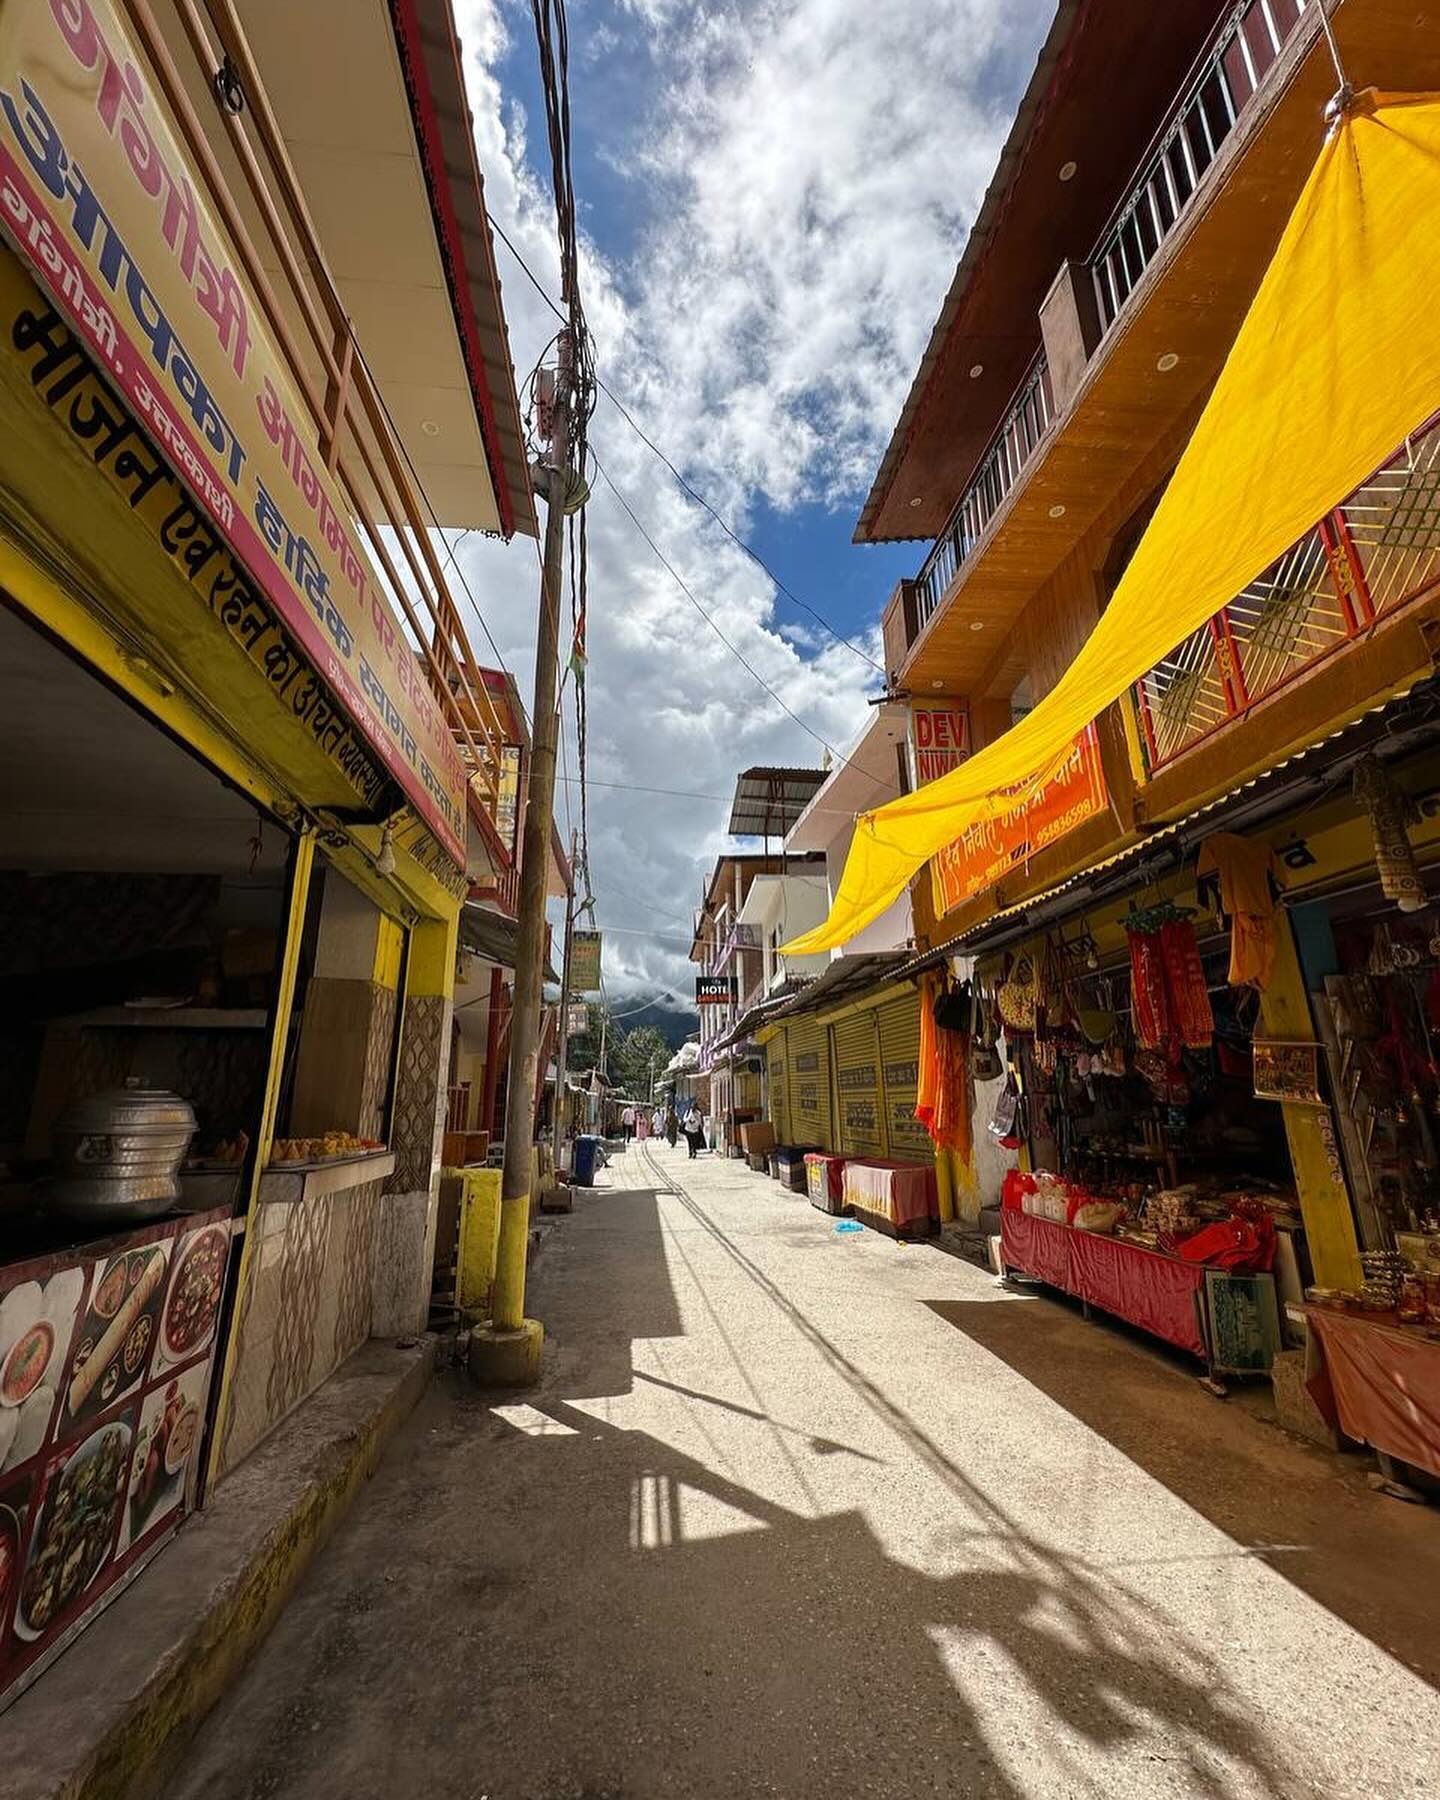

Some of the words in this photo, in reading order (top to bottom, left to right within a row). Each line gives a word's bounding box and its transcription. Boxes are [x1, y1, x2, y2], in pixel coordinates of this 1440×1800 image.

[0, 75, 248, 488] आपका
[253, 473, 357, 661] हार्दिक
[359, 651, 418, 769] स्वागत
[134, 368, 237, 532] उत्तरकाशी
[256, 376, 368, 609] आगमन
[371, 587, 396, 664] पर
[915, 712, 966, 749] DEV
